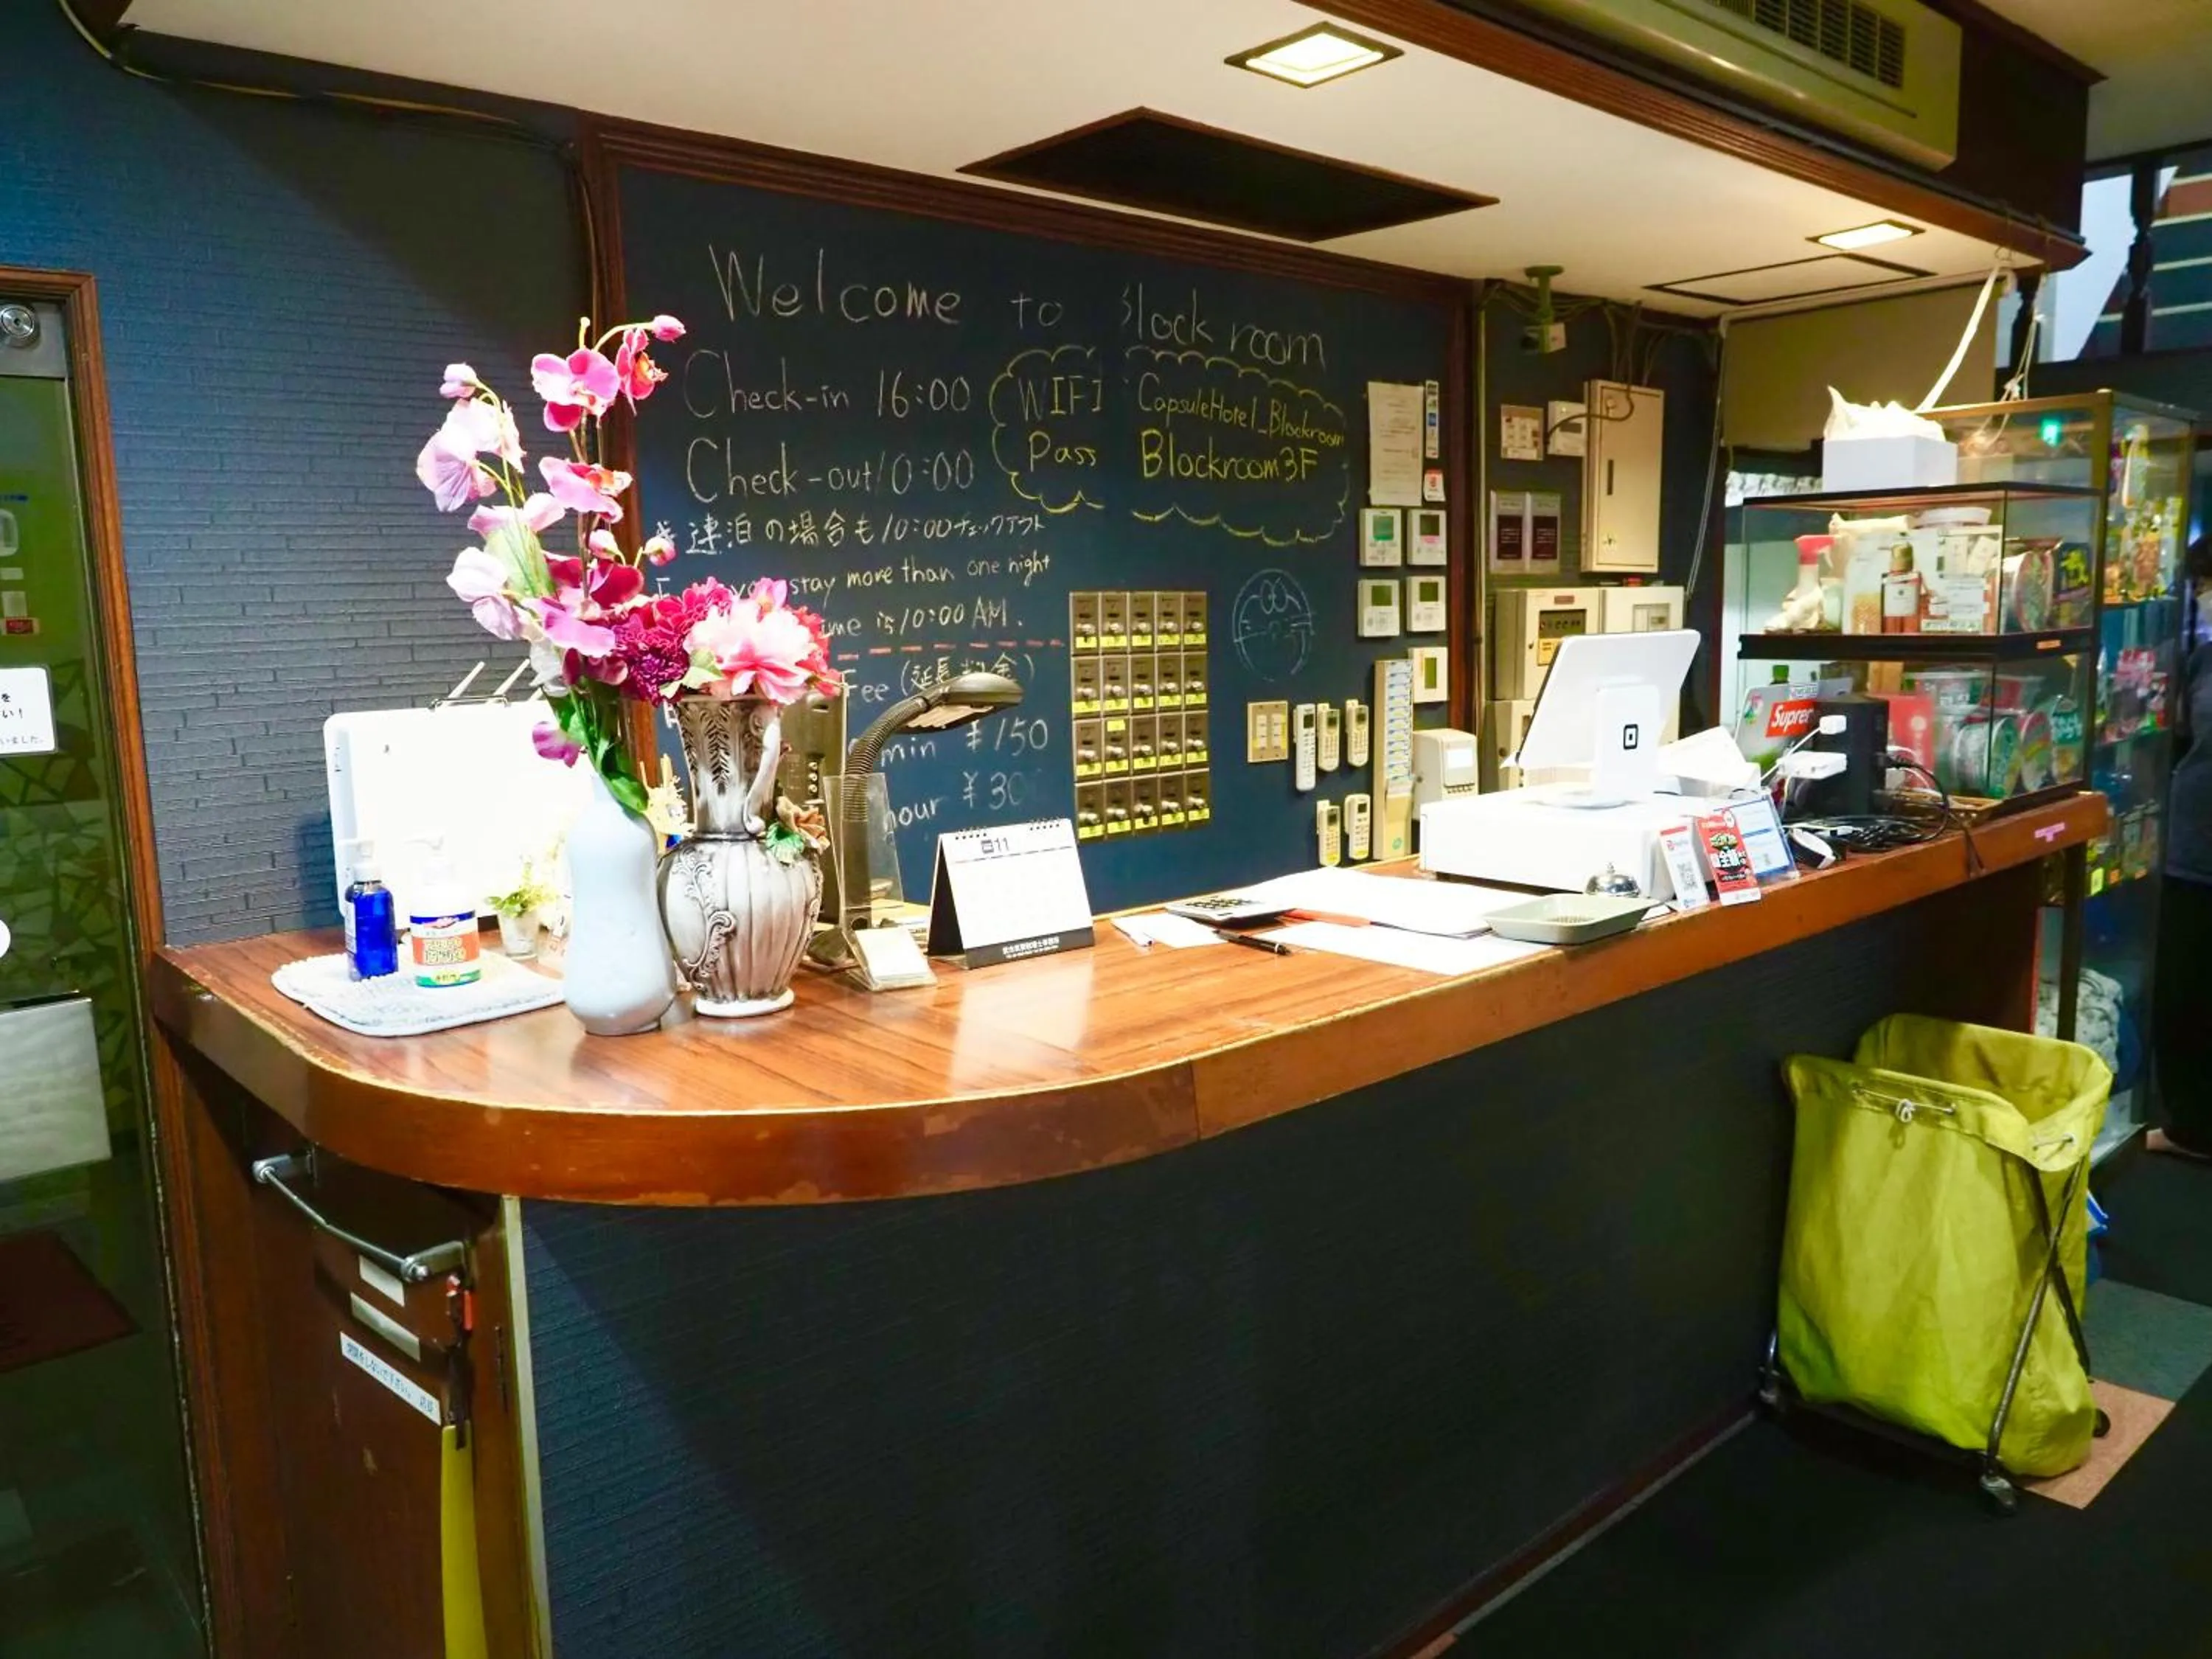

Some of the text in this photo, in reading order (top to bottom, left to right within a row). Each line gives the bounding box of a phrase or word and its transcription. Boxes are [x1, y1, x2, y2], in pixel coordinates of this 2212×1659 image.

[709, 243, 961, 324] Welcome
[1009, 293, 1062, 329] to
[1230, 323, 1327, 370] room
[684, 349, 972, 419] Check-in 16:00
[1018, 374, 1103, 422] WIFI
[686, 437, 975, 503] Check-out 10:00
[1029, 430, 1097, 473] Pass
[1140, 428, 1320, 483] Blockroom3F
[789, 577, 836, 611] stay
[847, 565, 894, 588] more
[901, 554, 955, 585] than
[967, 558, 1001, 576] one
[1007, 549, 1051, 588] night
[821, 616, 862, 637] ime
[899, 602, 964, 636] 10:00
